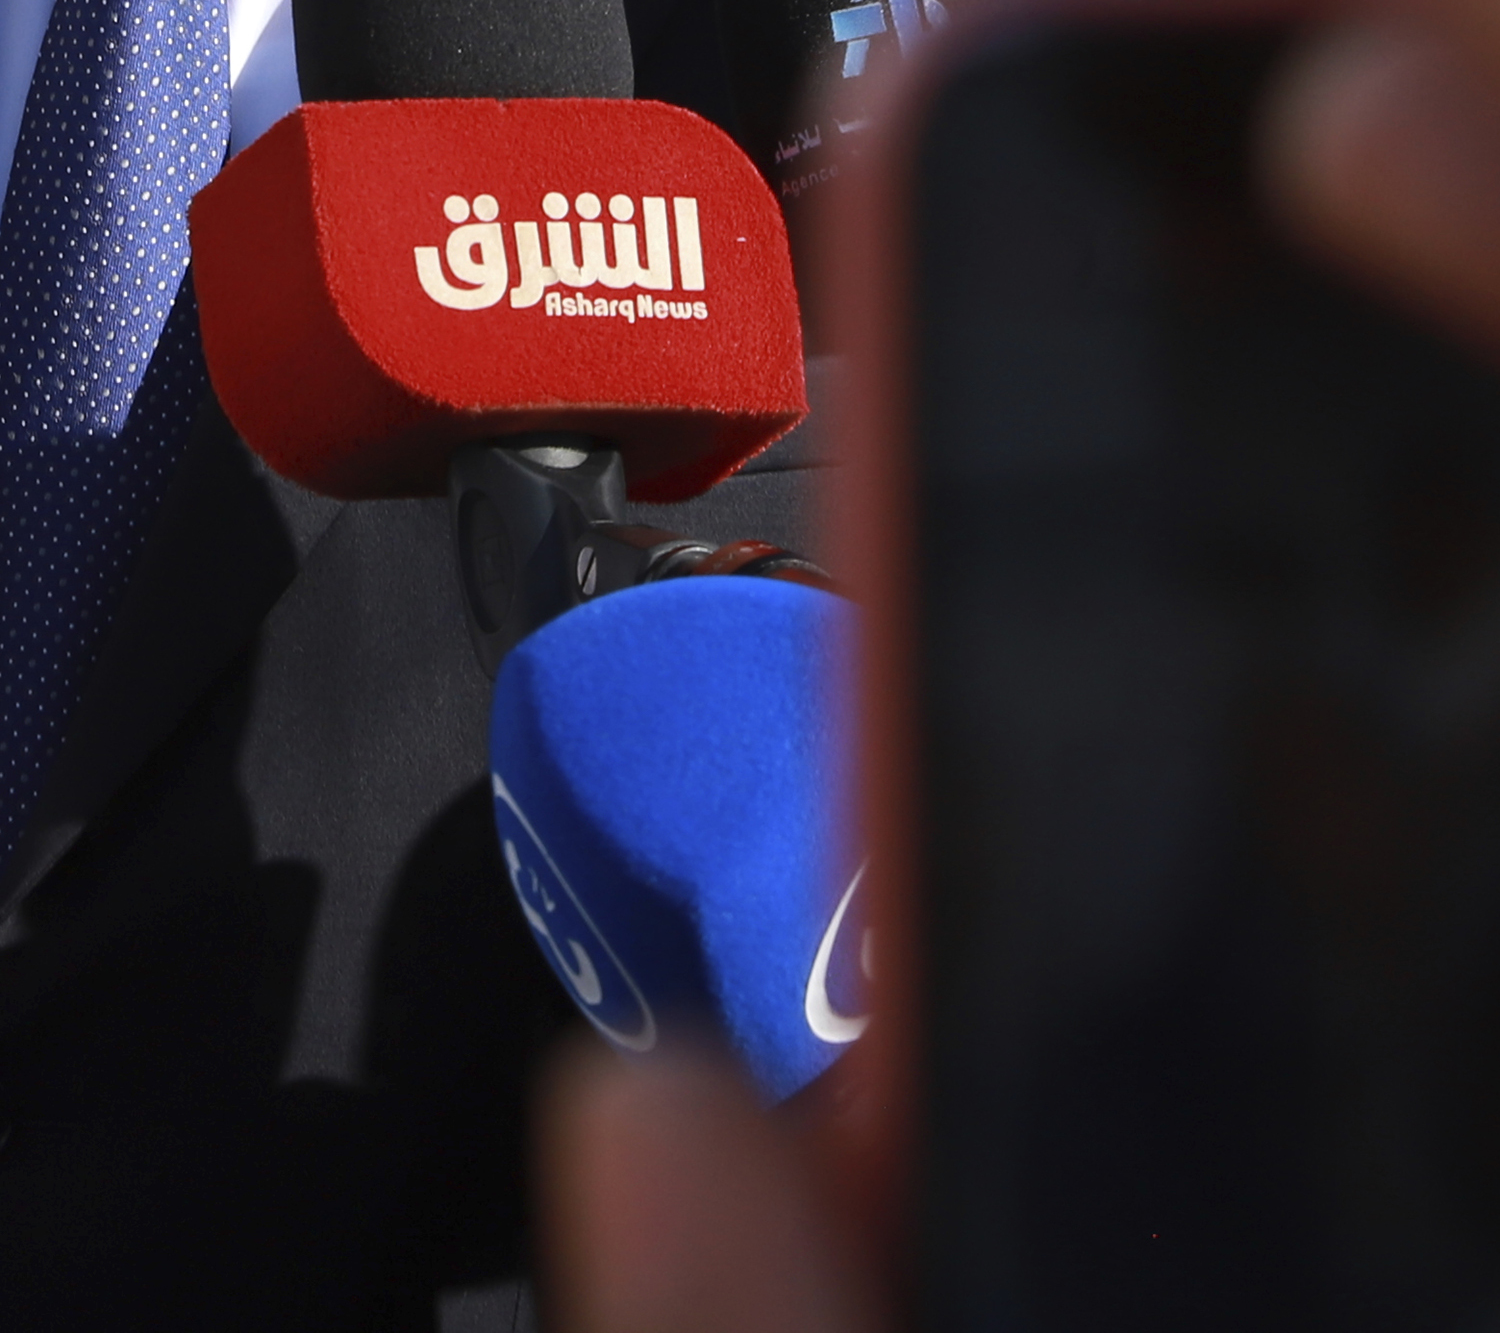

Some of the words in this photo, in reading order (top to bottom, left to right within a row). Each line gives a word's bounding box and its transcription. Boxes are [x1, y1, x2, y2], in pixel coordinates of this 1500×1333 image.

[780, 163, 839, 198] Agence
[412, 190, 708, 311] الشرق
[544, 291, 636, 324] Asharq
[635, 292, 708, 320] News
